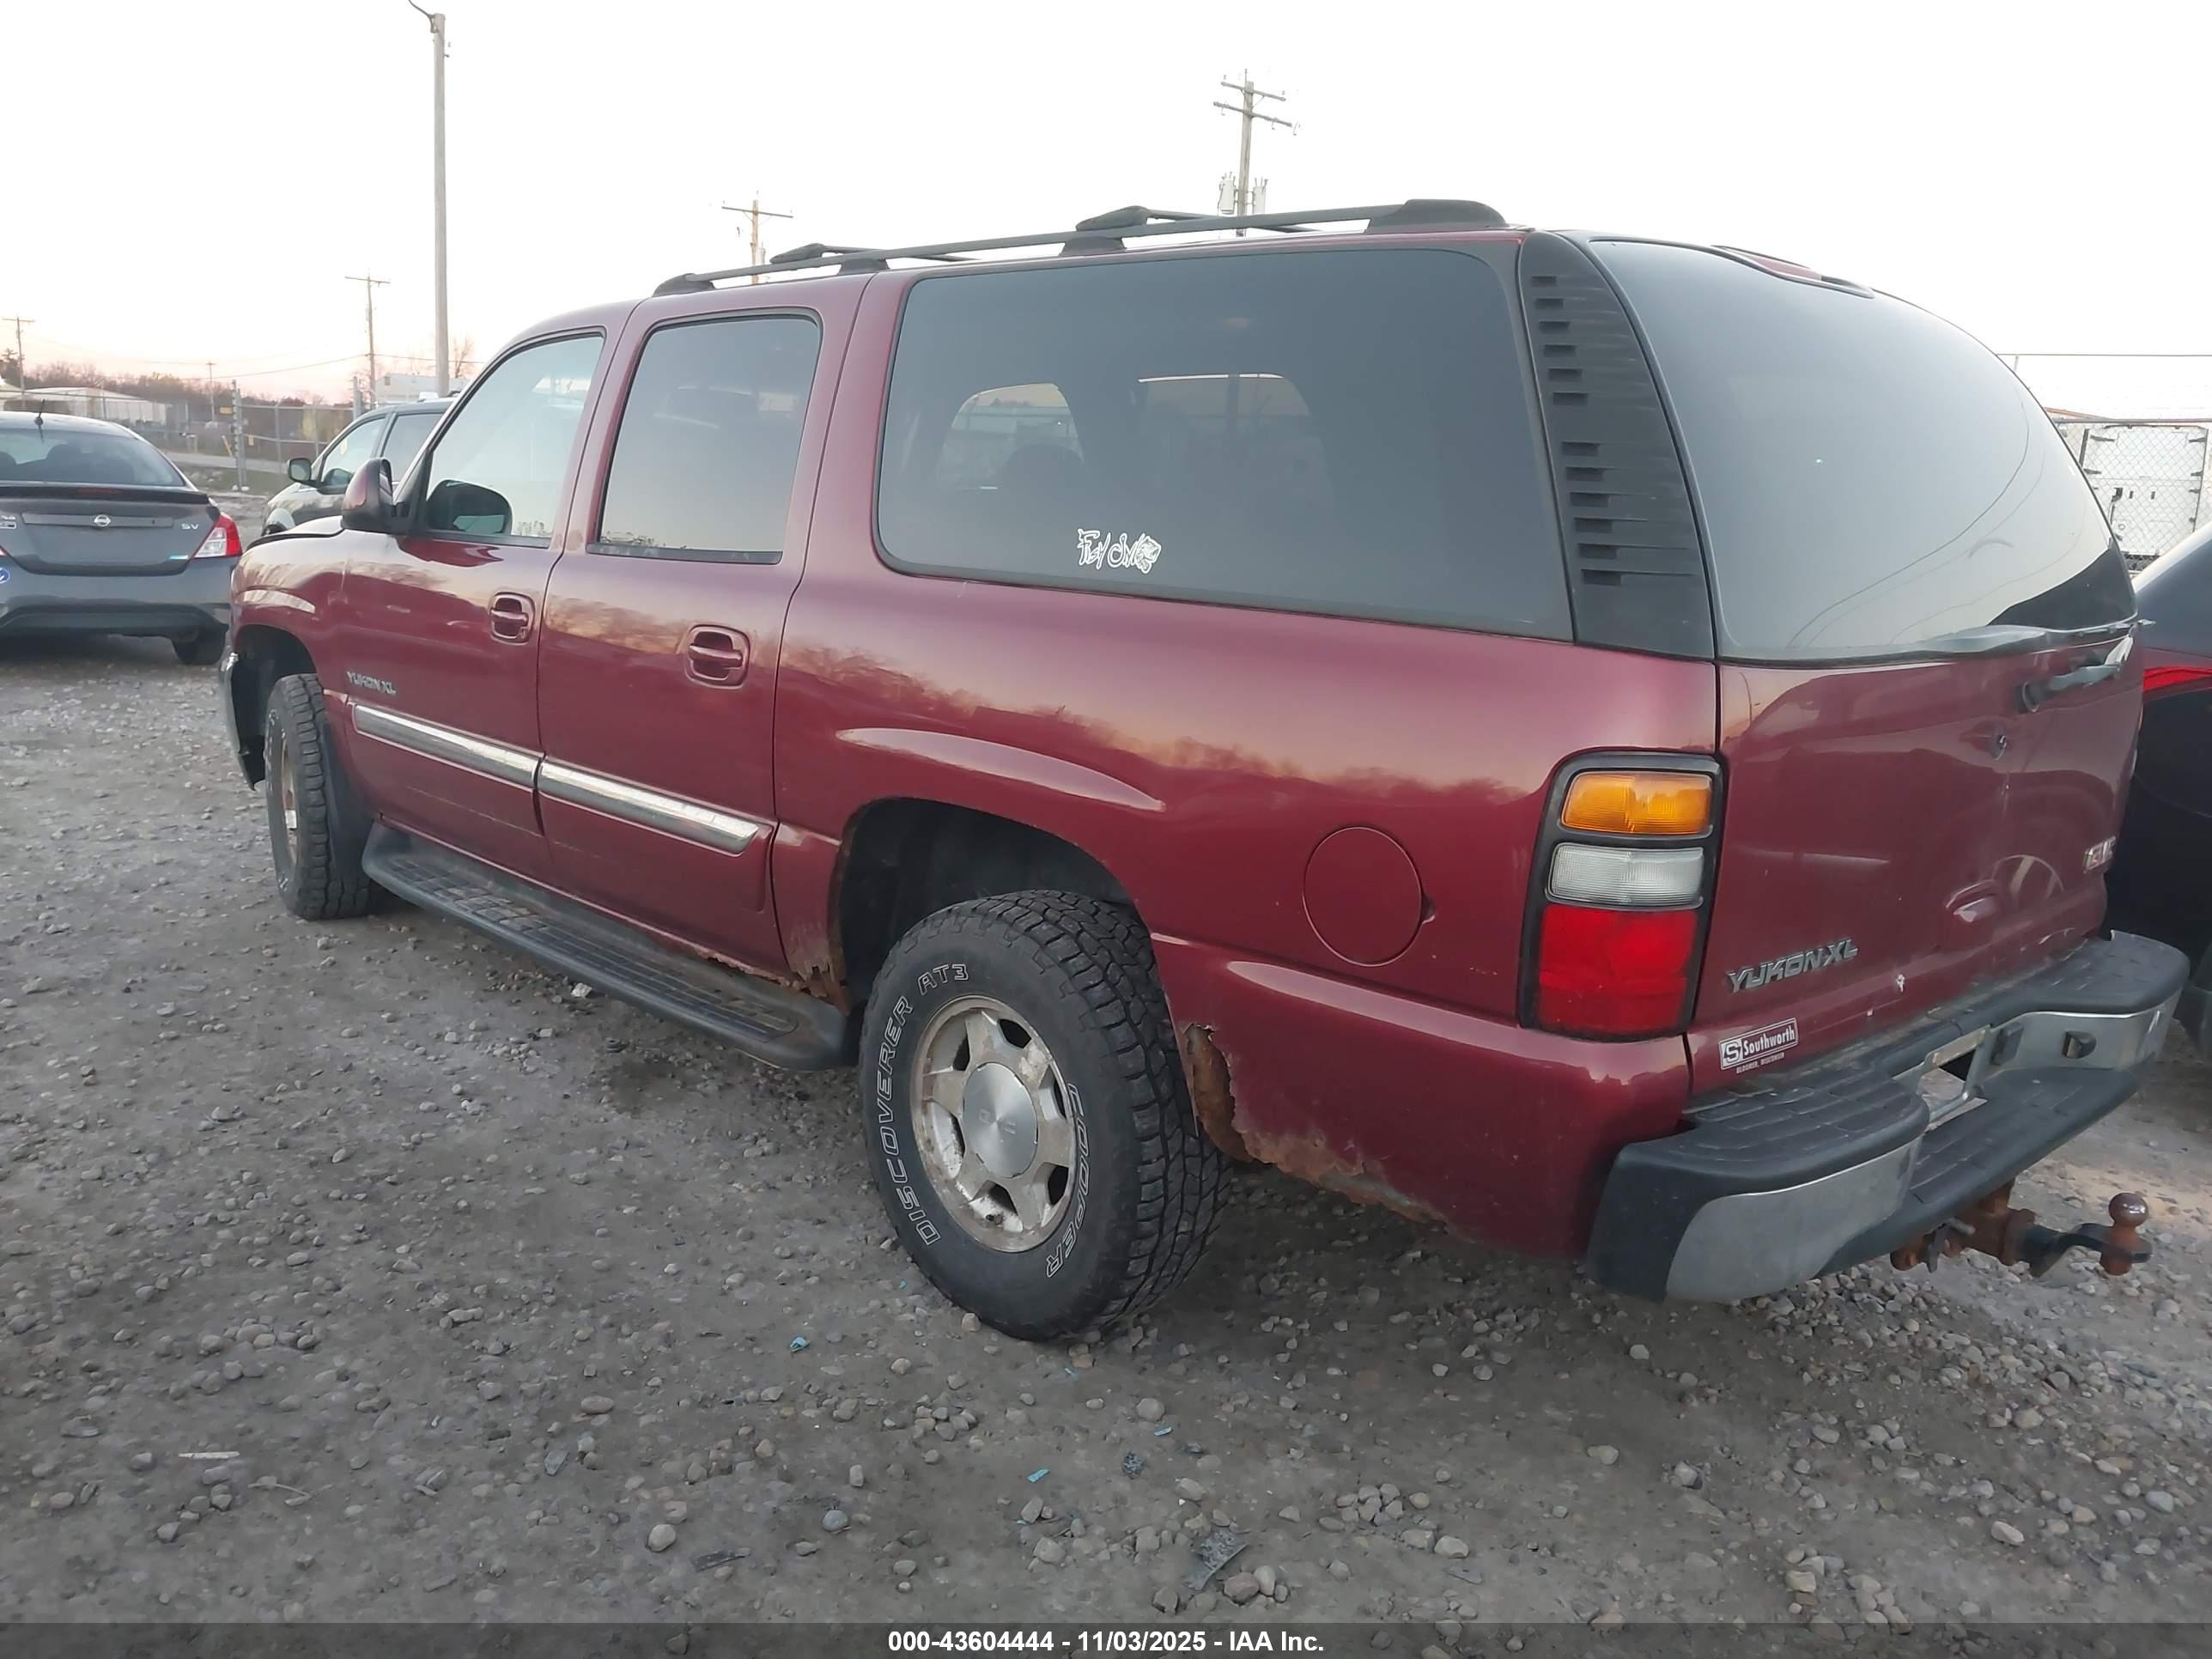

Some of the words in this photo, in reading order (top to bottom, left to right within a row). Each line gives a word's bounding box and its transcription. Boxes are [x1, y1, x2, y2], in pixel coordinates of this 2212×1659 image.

[346, 671, 380, 691] YUKON
[1727, 948, 1823, 993] YUKON
[1823, 939, 1859, 967] XL
[1742, 1024, 1796, 1056] Southworth
[876, 995, 943, 1246] DISCOVERER
[917, 963, 969, 996] AT3
[1046, 1082, 1091, 1279] COOPER
